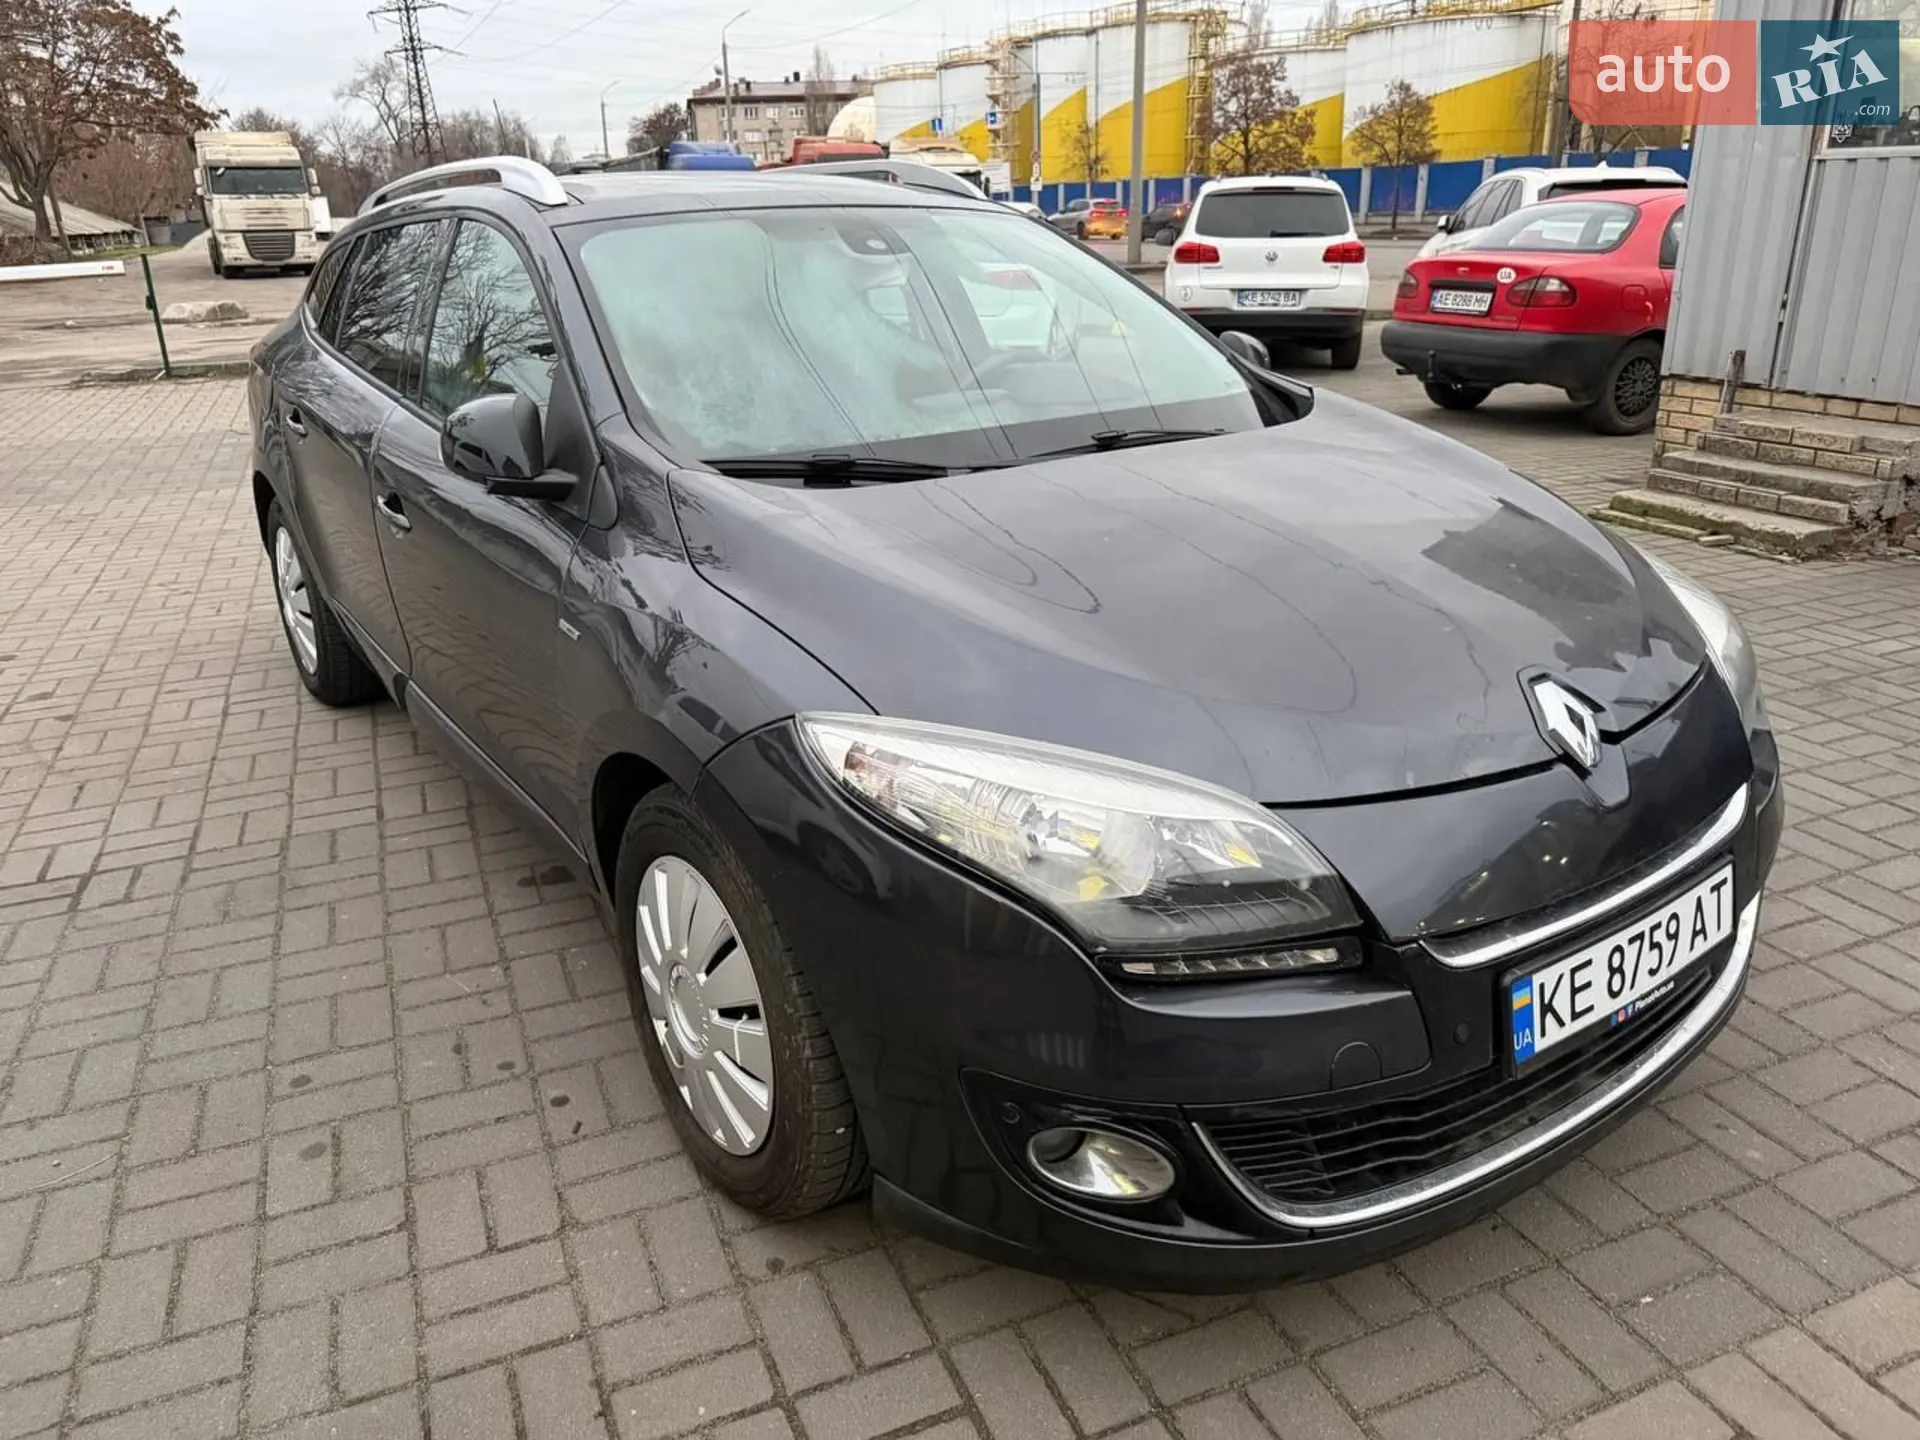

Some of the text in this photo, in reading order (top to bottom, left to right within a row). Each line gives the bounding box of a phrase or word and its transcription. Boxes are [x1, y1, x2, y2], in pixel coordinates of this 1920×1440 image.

[1438, 293, 1453, 306] AE
[1538, 876, 1729, 1039] KE 8759 AT
[1513, 1027, 1533, 1051] UA
